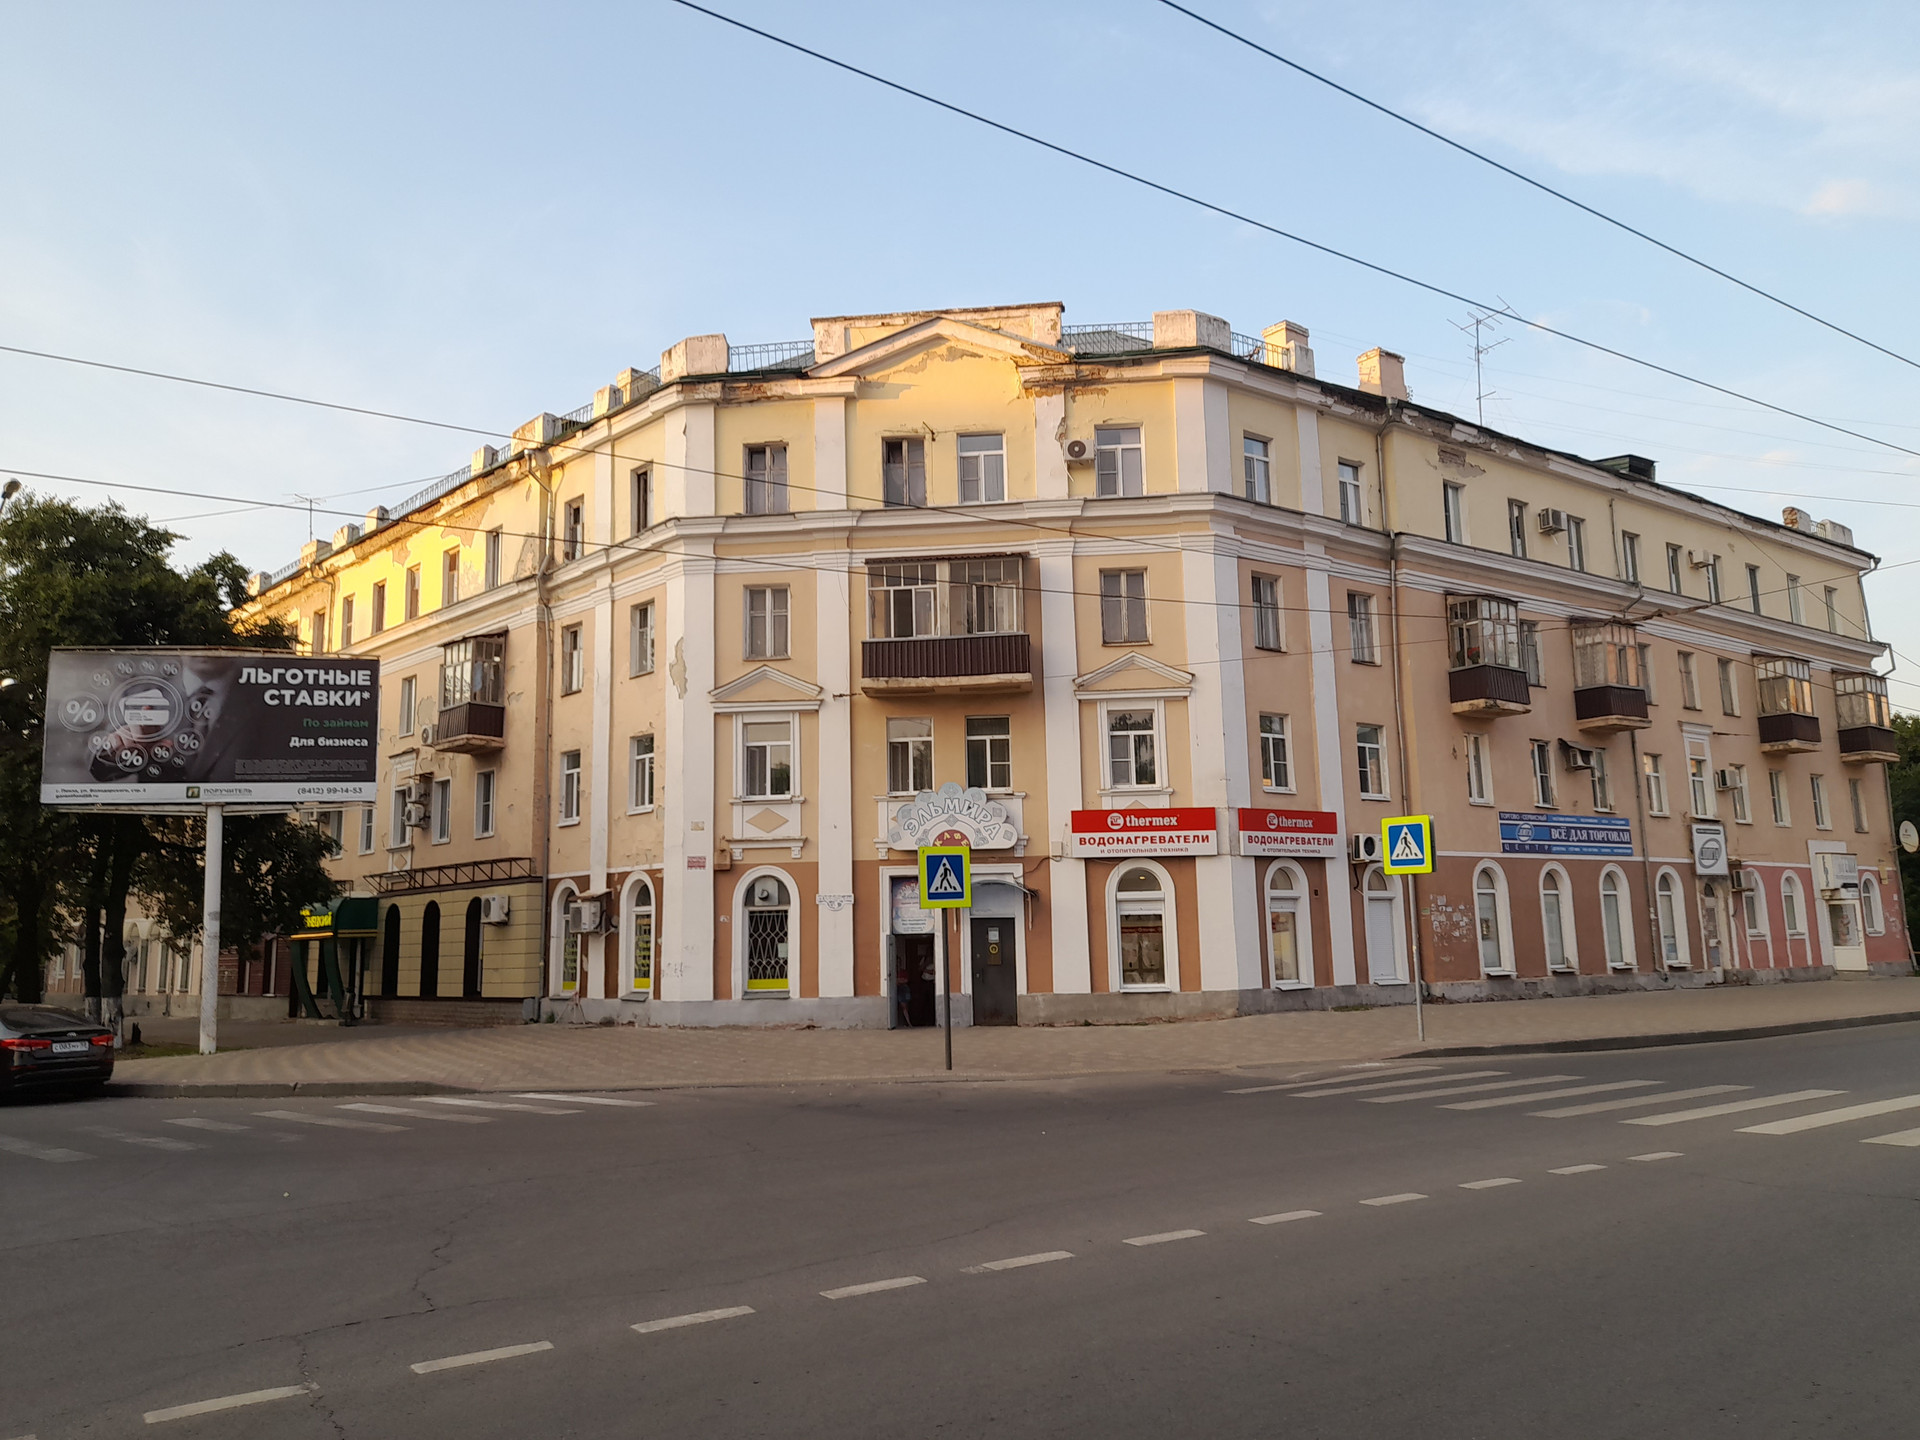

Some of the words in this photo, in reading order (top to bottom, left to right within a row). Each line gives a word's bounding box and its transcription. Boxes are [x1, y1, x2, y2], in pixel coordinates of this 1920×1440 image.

[238, 667, 372, 686] ЛЬГОТНЫЕ
[303, 718, 320, 728] По
[323, 717, 369, 728] займам
[289, 737, 315, 748] Для
[318, 736, 368, 747] бизнеса
[203, 787, 253, 795] ПОРУЧИТЕЛЬ
[297, 787, 324, 796] (8412)
[326, 787, 363, 795] 99-14-53
[903, 798, 1001, 840] ЭЛЬМИРА
[1125, 814, 1178, 827] thermex
[1279, 816, 1313, 828] thermex
[1079, 834, 1210, 847] ВОДОНАГРЕВАТЕЛИ
[1247, 835, 1334, 846] ВОДОНАГРЕВАТЕЛИ
[1551, 827, 1568, 840] ВСЁ
[1569, 829, 1588, 842] ДЛЯ
[1588, 829, 1631, 842] ТОРГОВЛИ
